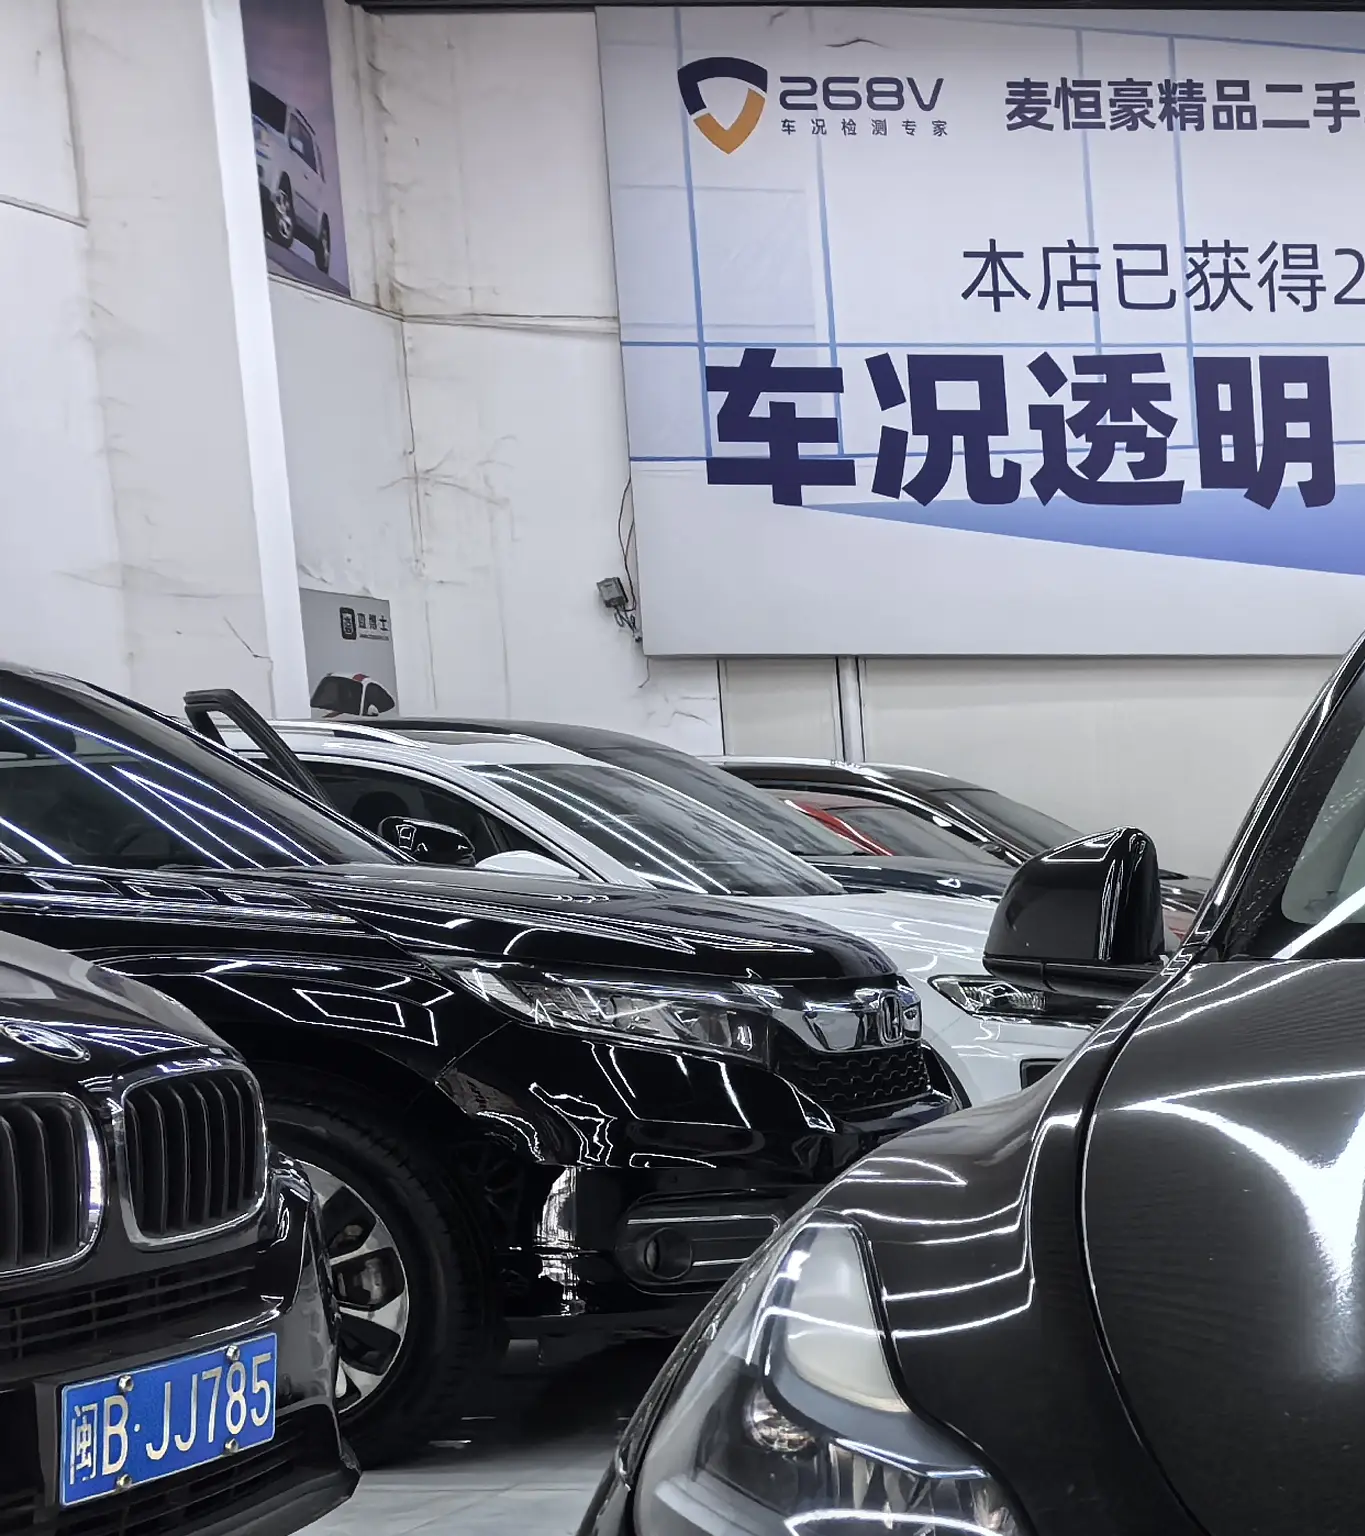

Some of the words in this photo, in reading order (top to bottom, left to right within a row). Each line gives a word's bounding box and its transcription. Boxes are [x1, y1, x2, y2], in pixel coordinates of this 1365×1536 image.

[778, 75, 944, 112] 268V
[779, 118, 949, 137] 车况检测专家
[705, 348, 1336, 509] 车况透明
